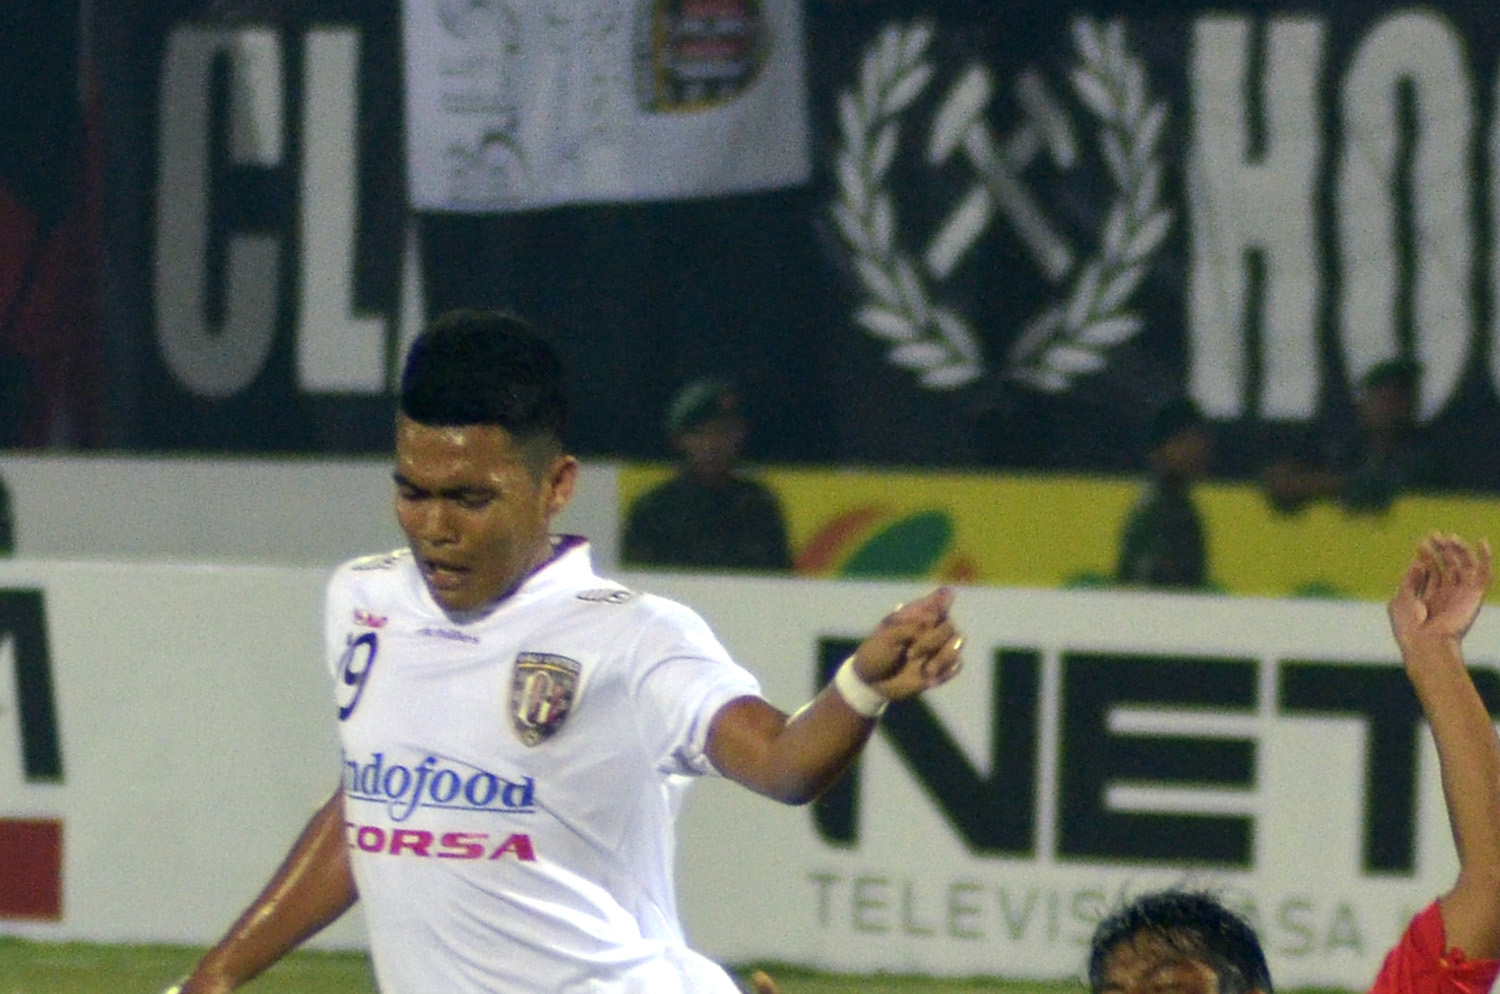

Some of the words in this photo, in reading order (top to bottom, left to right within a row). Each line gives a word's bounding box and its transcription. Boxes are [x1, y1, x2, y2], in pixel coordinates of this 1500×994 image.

[155, 25, 425, 399] CL
[344, 752, 536, 823] ndofood
[346, 820, 537, 861] ORSA
